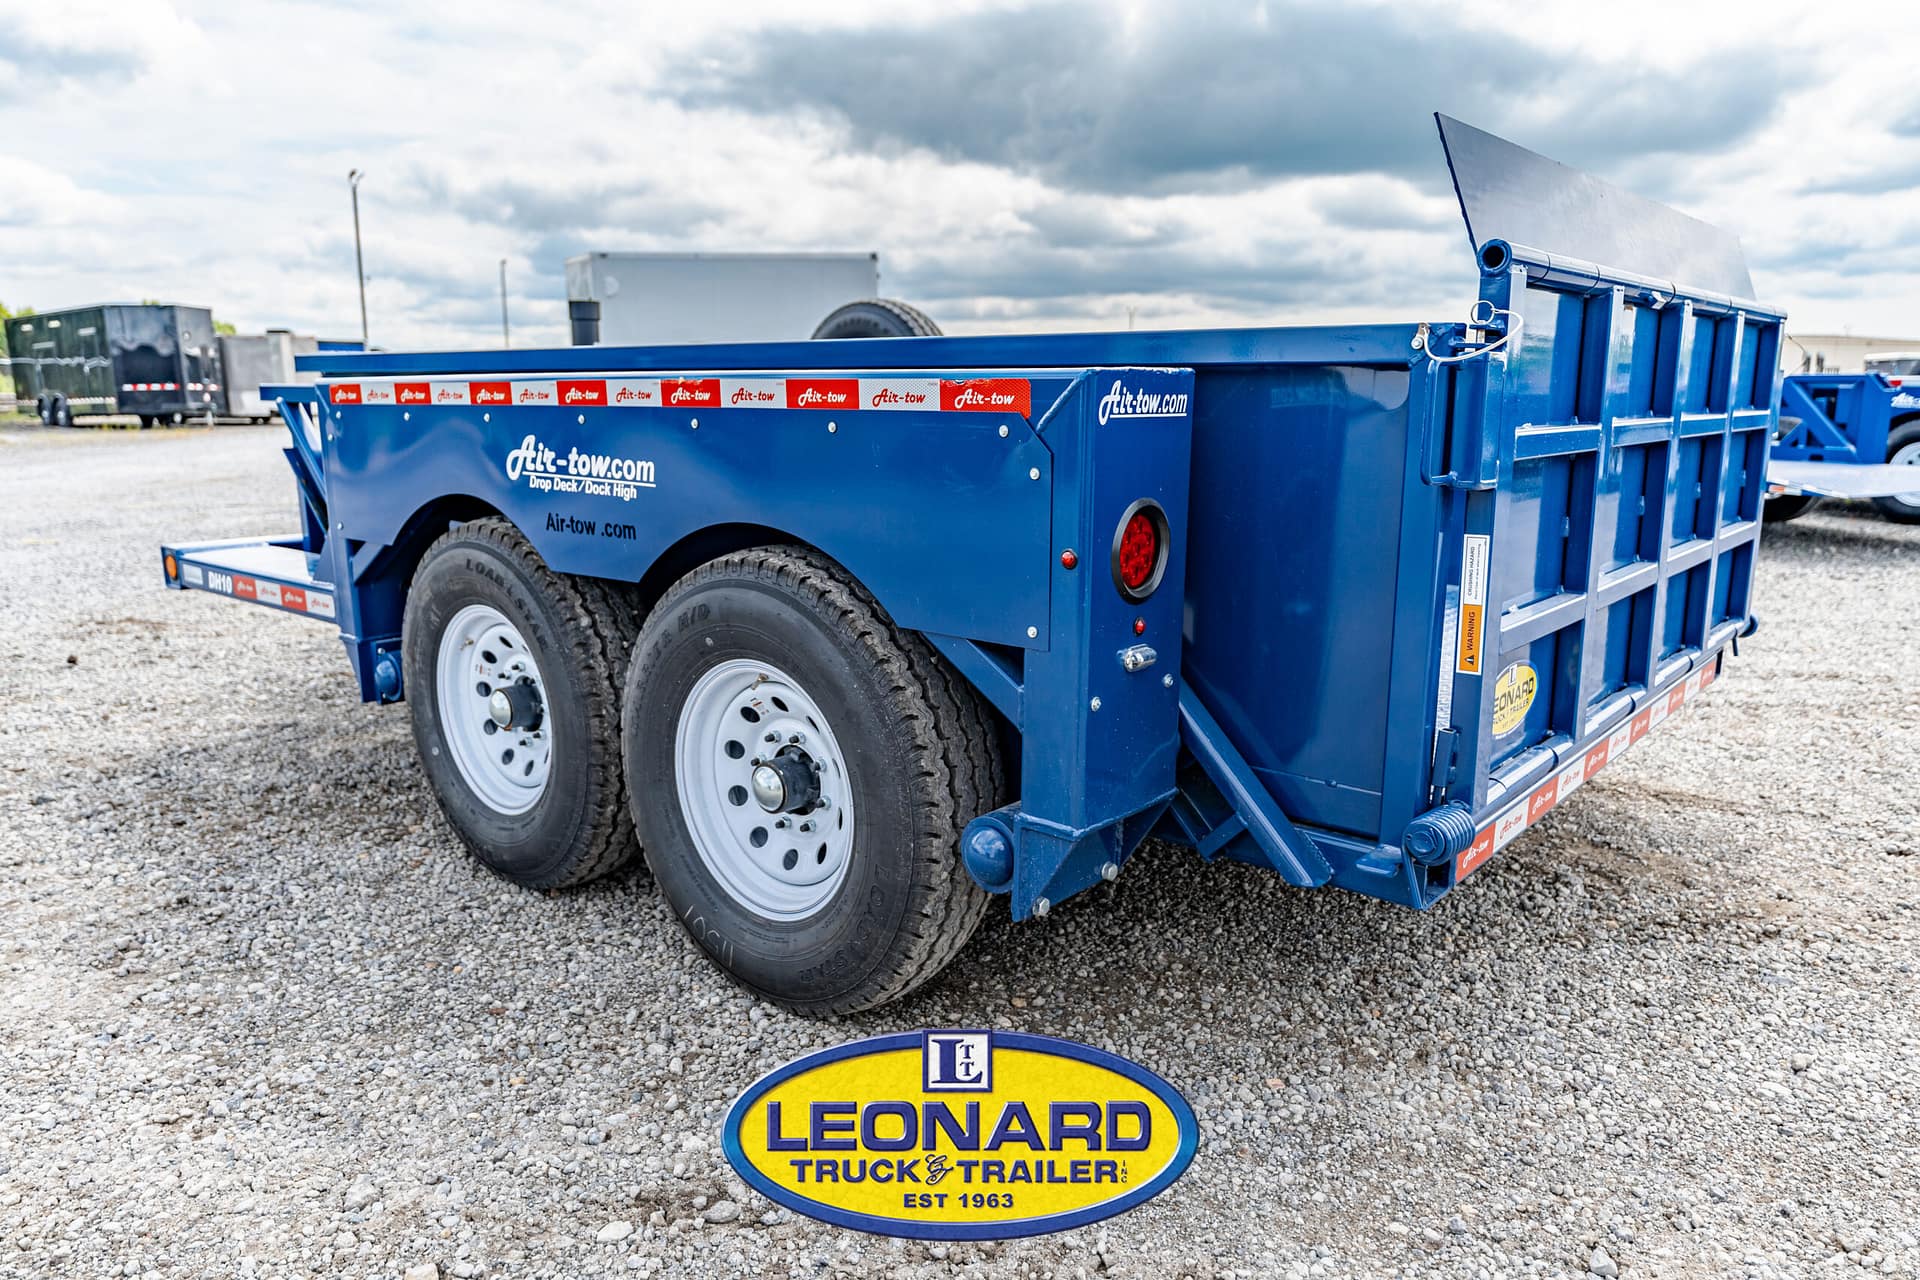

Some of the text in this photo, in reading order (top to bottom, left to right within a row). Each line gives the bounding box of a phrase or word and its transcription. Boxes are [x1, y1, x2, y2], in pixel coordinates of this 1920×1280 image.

[476, 388, 505, 404] Air-tow
[519, 388, 549, 403] Air-tow
[565, 387, 600, 404] Air-tow
[615, 387, 652, 403] Air-tow
[671, 387, 711, 404] Air-tow
[731, 387, 775, 405] Air-tow
[798, 388, 847, 407] Air-tow
[872, 388, 926, 408] Air-tow
[954, 388, 1015, 409] Air-tow
[1098, 380, 1188, 425] Air-tow.com
[506, 434, 655, 482] Air-tow.com
[529, 475, 552, 493] Drop
[613, 483, 637, 502] High
[545, 512, 596, 536] Air-tow
[207, 571, 233, 594] DH10
[1466, 611, 1476, 650] WARNING
[1494, 677, 1534, 714] EONARD
